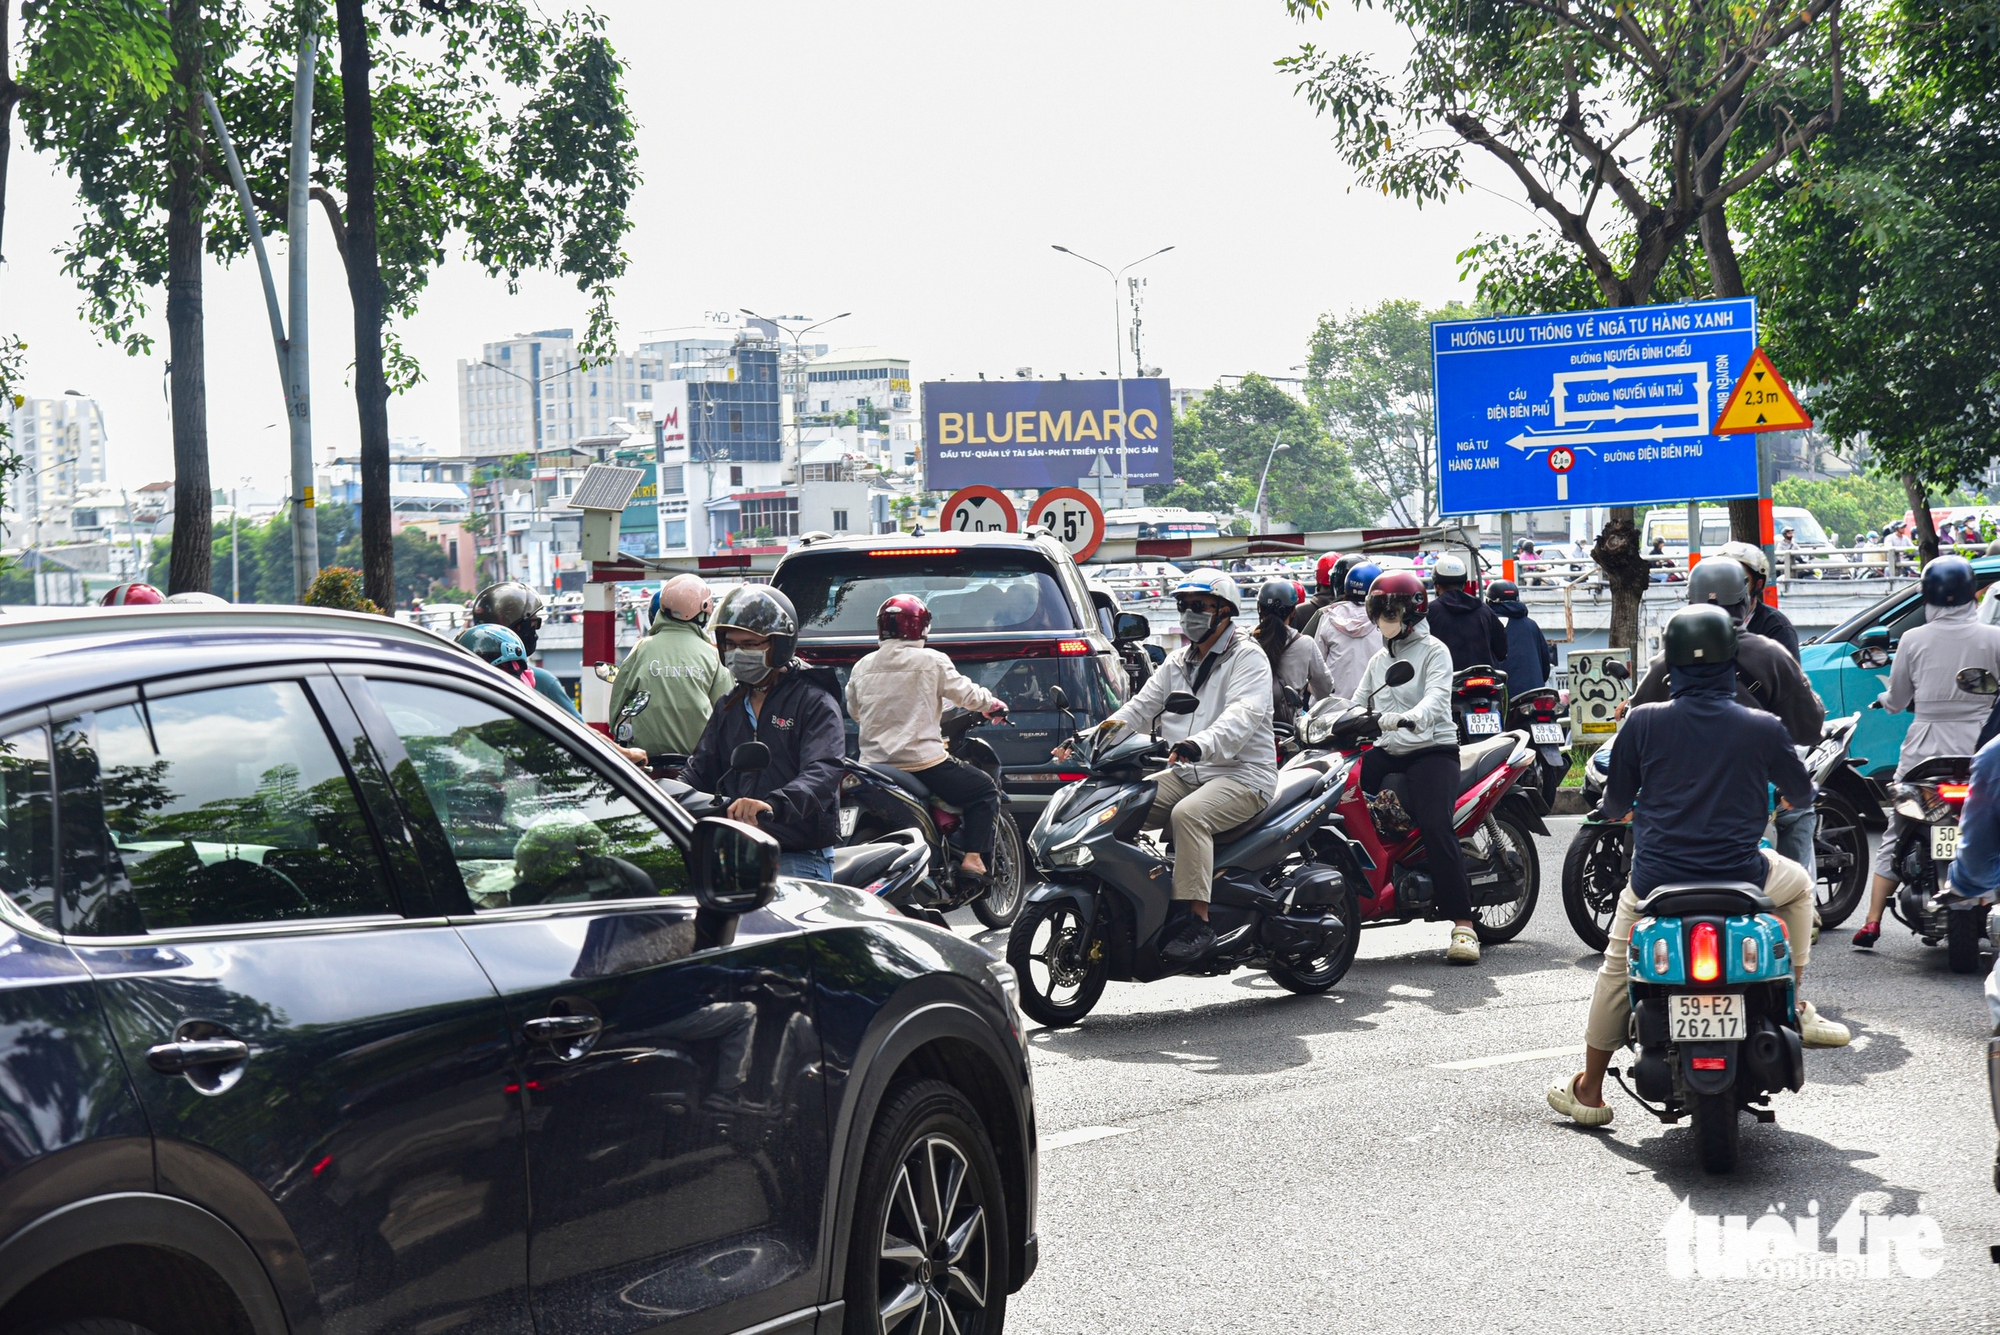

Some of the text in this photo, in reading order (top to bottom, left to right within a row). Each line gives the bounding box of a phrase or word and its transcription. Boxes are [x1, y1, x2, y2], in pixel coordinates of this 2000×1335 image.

[1451, 311, 1733, 347] HƯỚNG LƯU THÔNG VỀ NGÃ TƯ HÀNG XANH
[1570, 339, 1692, 365] ĐƯỜNG NGUYỄN ĐÌNH CHIỂU
[1577, 378, 1683, 404] ĐƯỜNG NGUYỄN VĂN THỦ
[1745, 390, 1778, 406] 2,3 m
[1487, 399, 1550, 422] ĐIỆN BIÊN PHỦ
[939, 408, 1158, 445] BLUEMARQ
[960, 450, 972, 458] TƯ
[975, 449, 999, 459] QUẢN
[1001, 449, 1011, 458] LÝ
[1012, 448, 1026, 457] TÀI
[1027, 447, 1044, 457] SẢN
[1048, 447, 1070, 456] PHÁT
[1072, 446, 1096, 456] TRIỂN
[1141, 444, 1159, 454] SẢN
[1456, 438, 1489, 451] NGÃ TƯ
[1603, 440, 1703, 462] ĐƯỜNG ĐIỆN BIÊN PHỦ
[1448, 455, 1500, 471] HÀNG XANH
[1470, 723, 1499, 733] 407.25
[1471, 714, 1495, 724] 83-P4
[1936, 843, 1957, 857] 89
[1680, 996, 1733, 1016] 59-E2
[1676, 1017, 1738, 1038] 262.17
